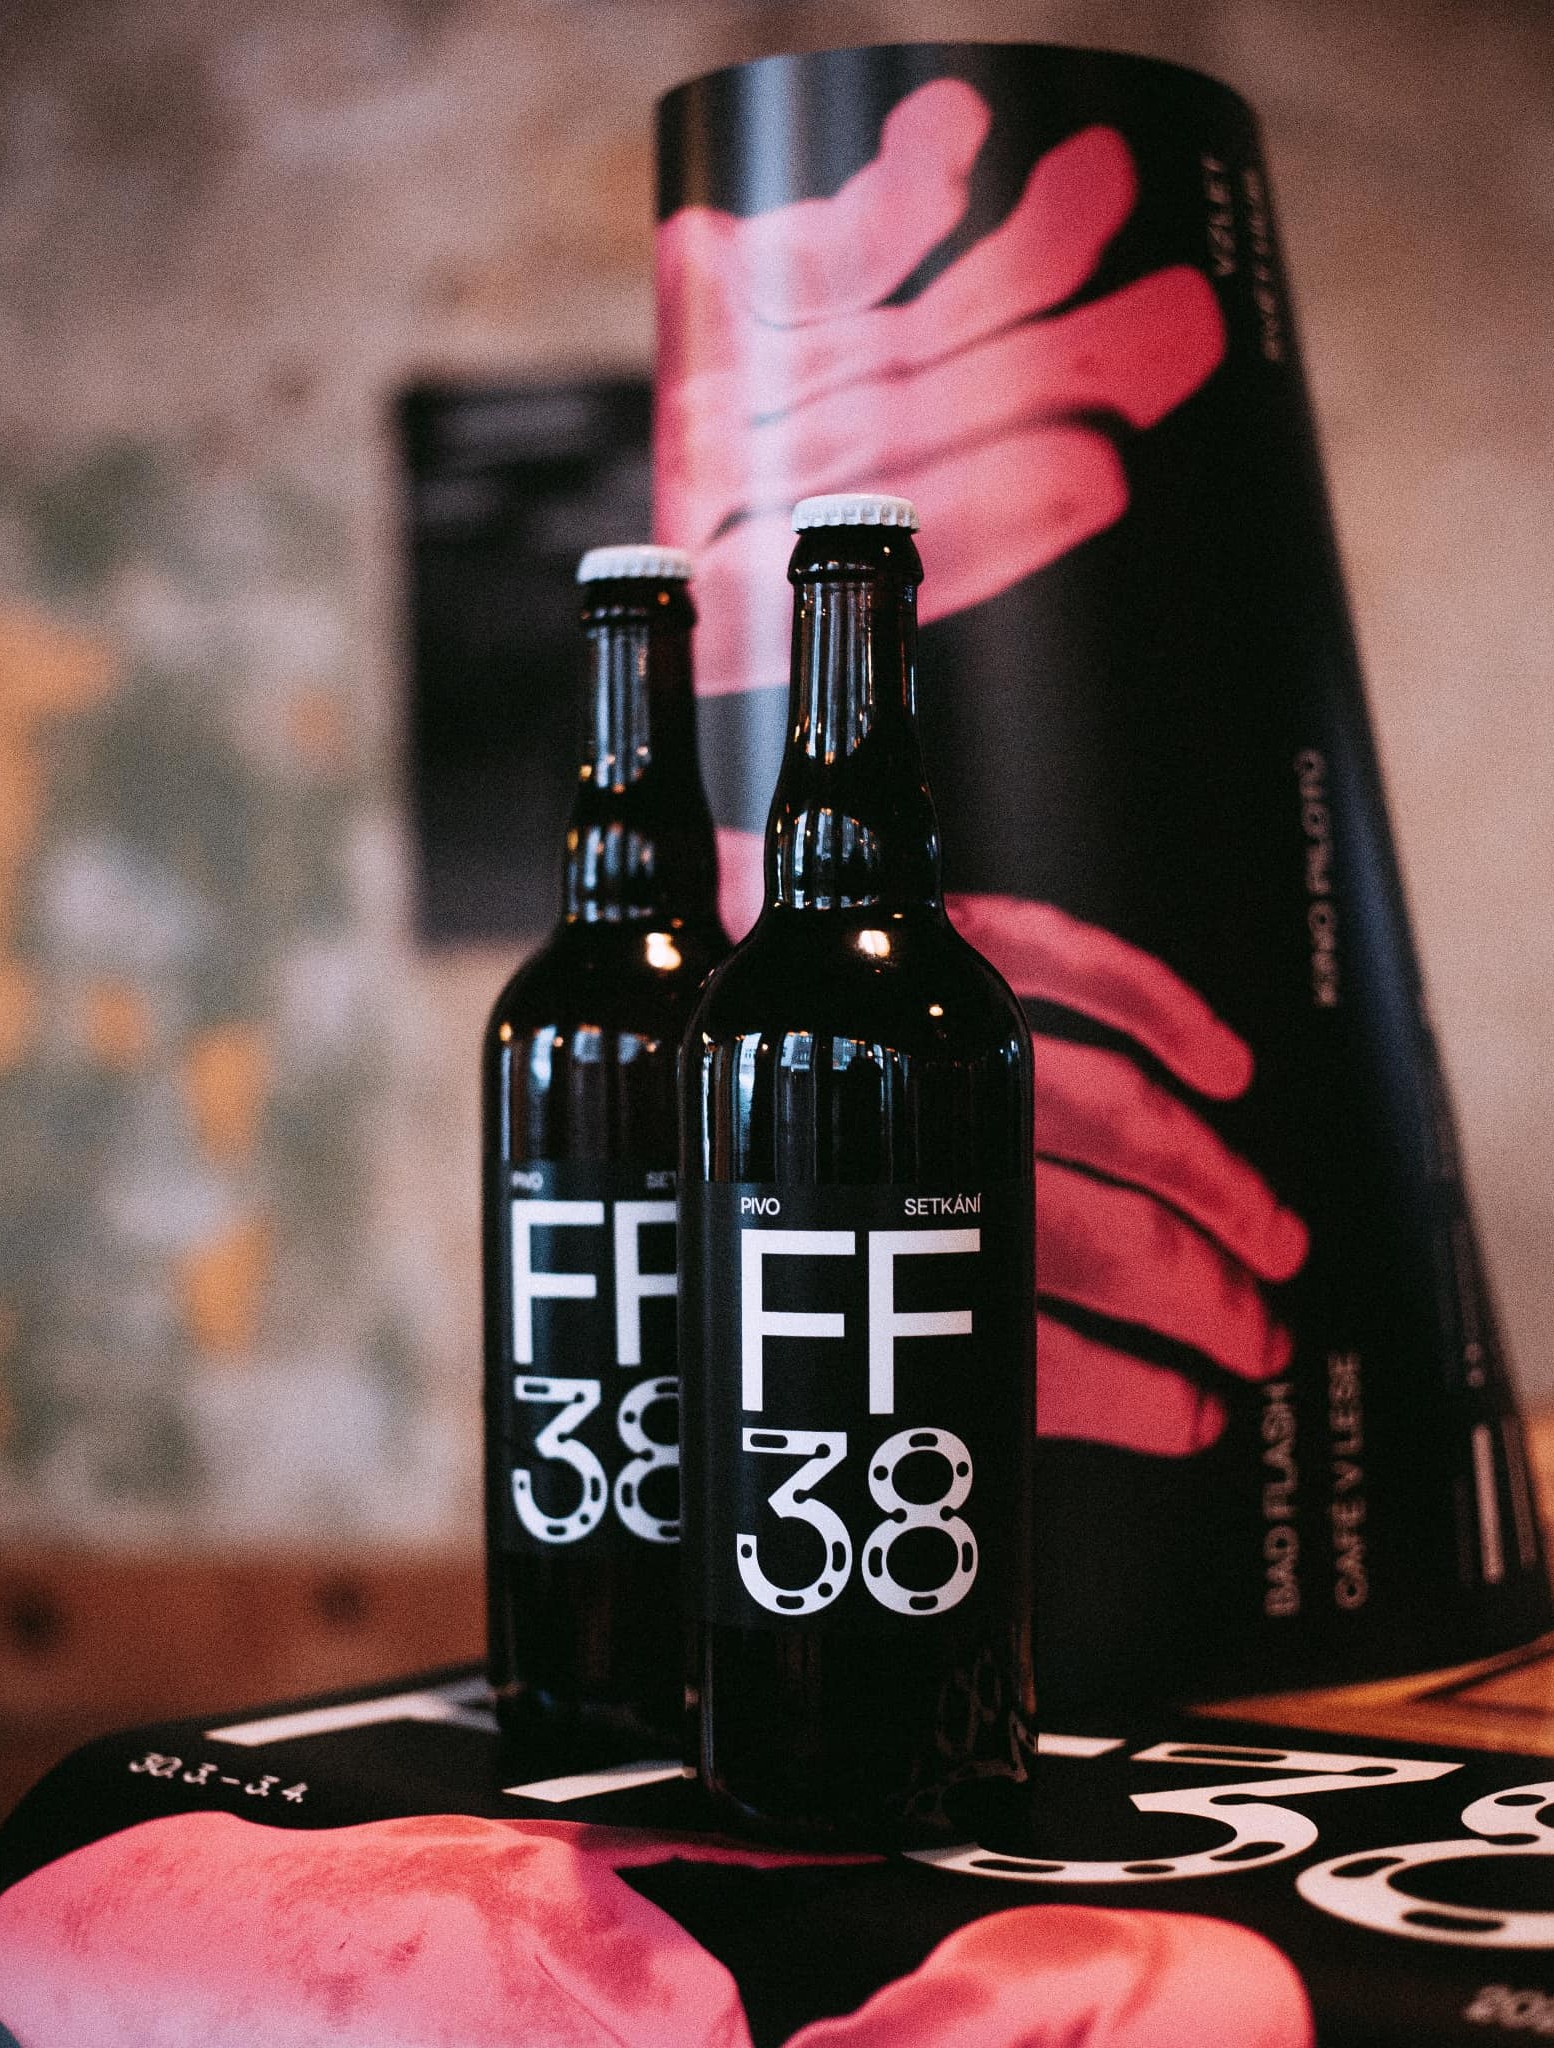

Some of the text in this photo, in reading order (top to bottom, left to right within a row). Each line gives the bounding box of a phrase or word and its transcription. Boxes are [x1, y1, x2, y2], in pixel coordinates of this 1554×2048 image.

[511, 1200, 678, 1367] FF
[740, 1193, 982, 1216] PIVO SETKÁNÍ
[741, 1228, 981, 1415] FF
[736, 1426, 979, 1616] 38
[1261, 1382, 1300, 1617] BAD FLASH
[1332, 1459, 1363, 1492] V
